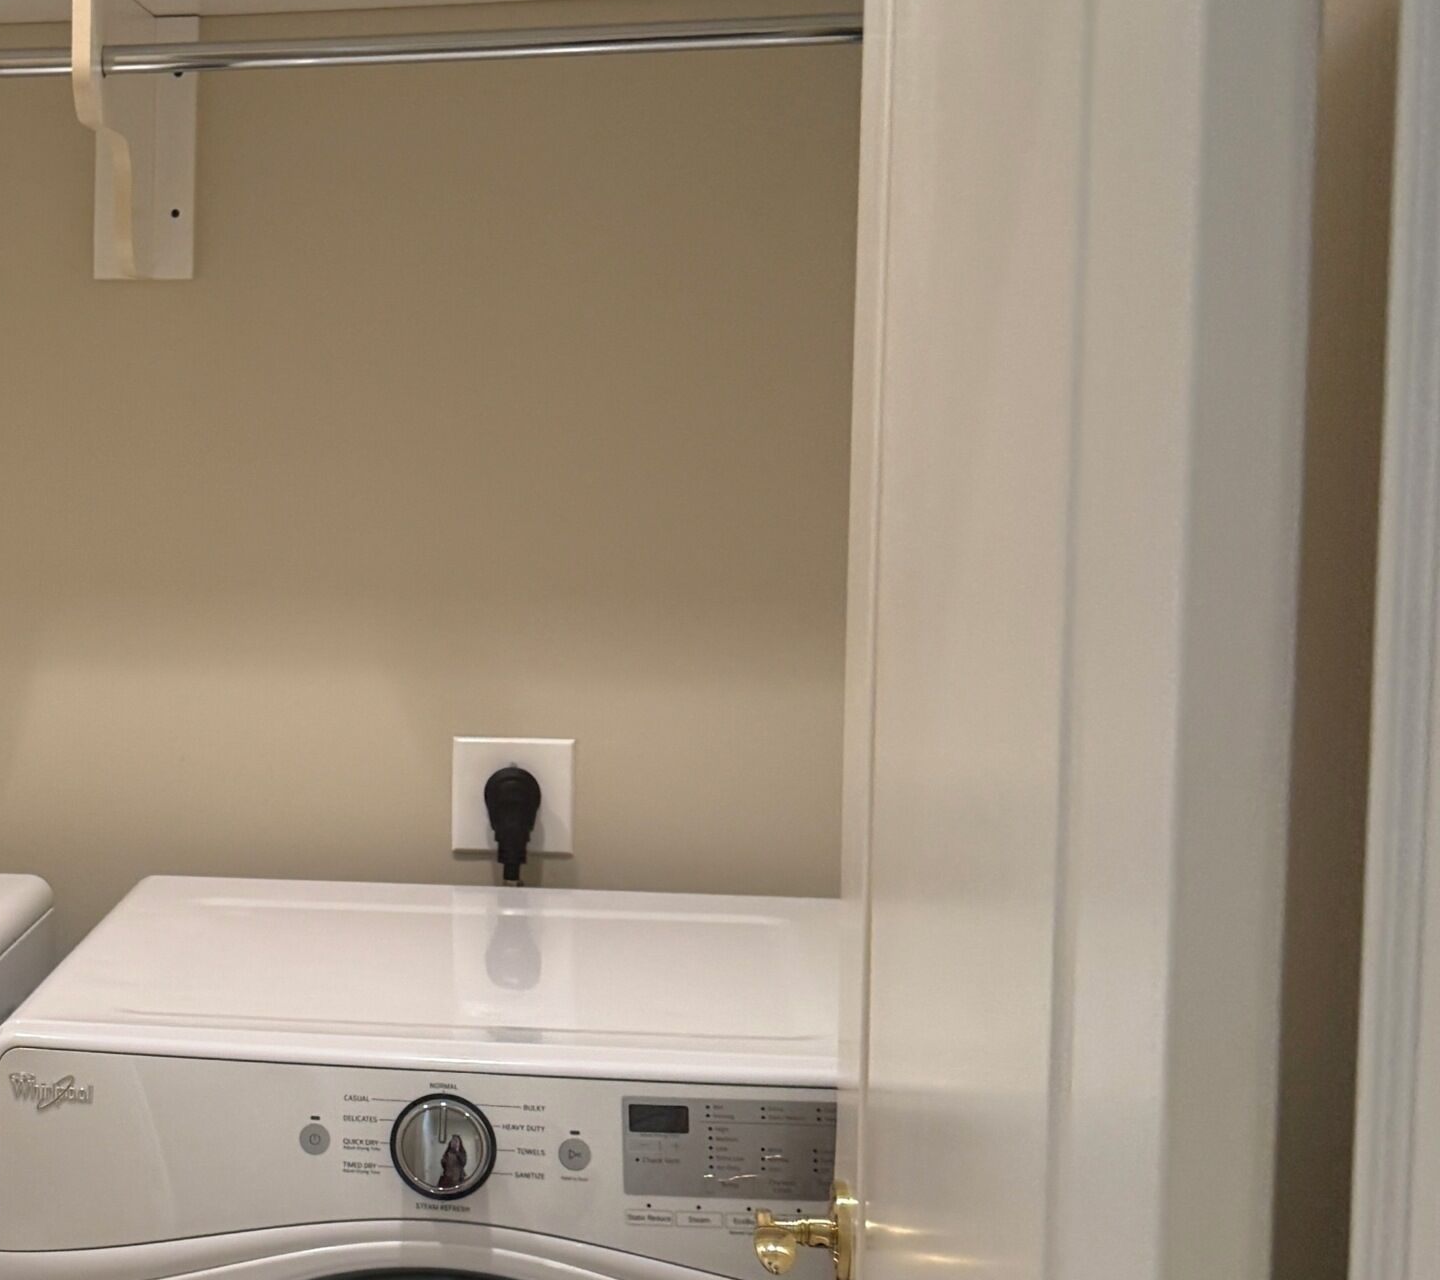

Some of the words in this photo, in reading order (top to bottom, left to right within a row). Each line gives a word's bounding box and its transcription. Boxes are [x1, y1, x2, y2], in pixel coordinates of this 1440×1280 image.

[429, 1082, 458, 1091] NORMAL
[9, 1073, 94, 1111] Whirlpool
[343, 1094, 370, 1102] CASUAL
[522, 1103, 546, 1112] BULKY
[343, 1115, 378, 1123] DELICATES
[502, 1123, 524, 1132] HEAVY
[526, 1124, 546, 1133] DUTY
[343, 1138, 364, 1146] QUICK
[517, 1147, 546, 1156] TOWELS
[343, 1161, 362, 1169] TIMED
[515, 1170, 545, 1180] SANITIZE
[415, 1202, 438, 1211] STEAM
[439, 1204, 470, 1212] REFRESH
